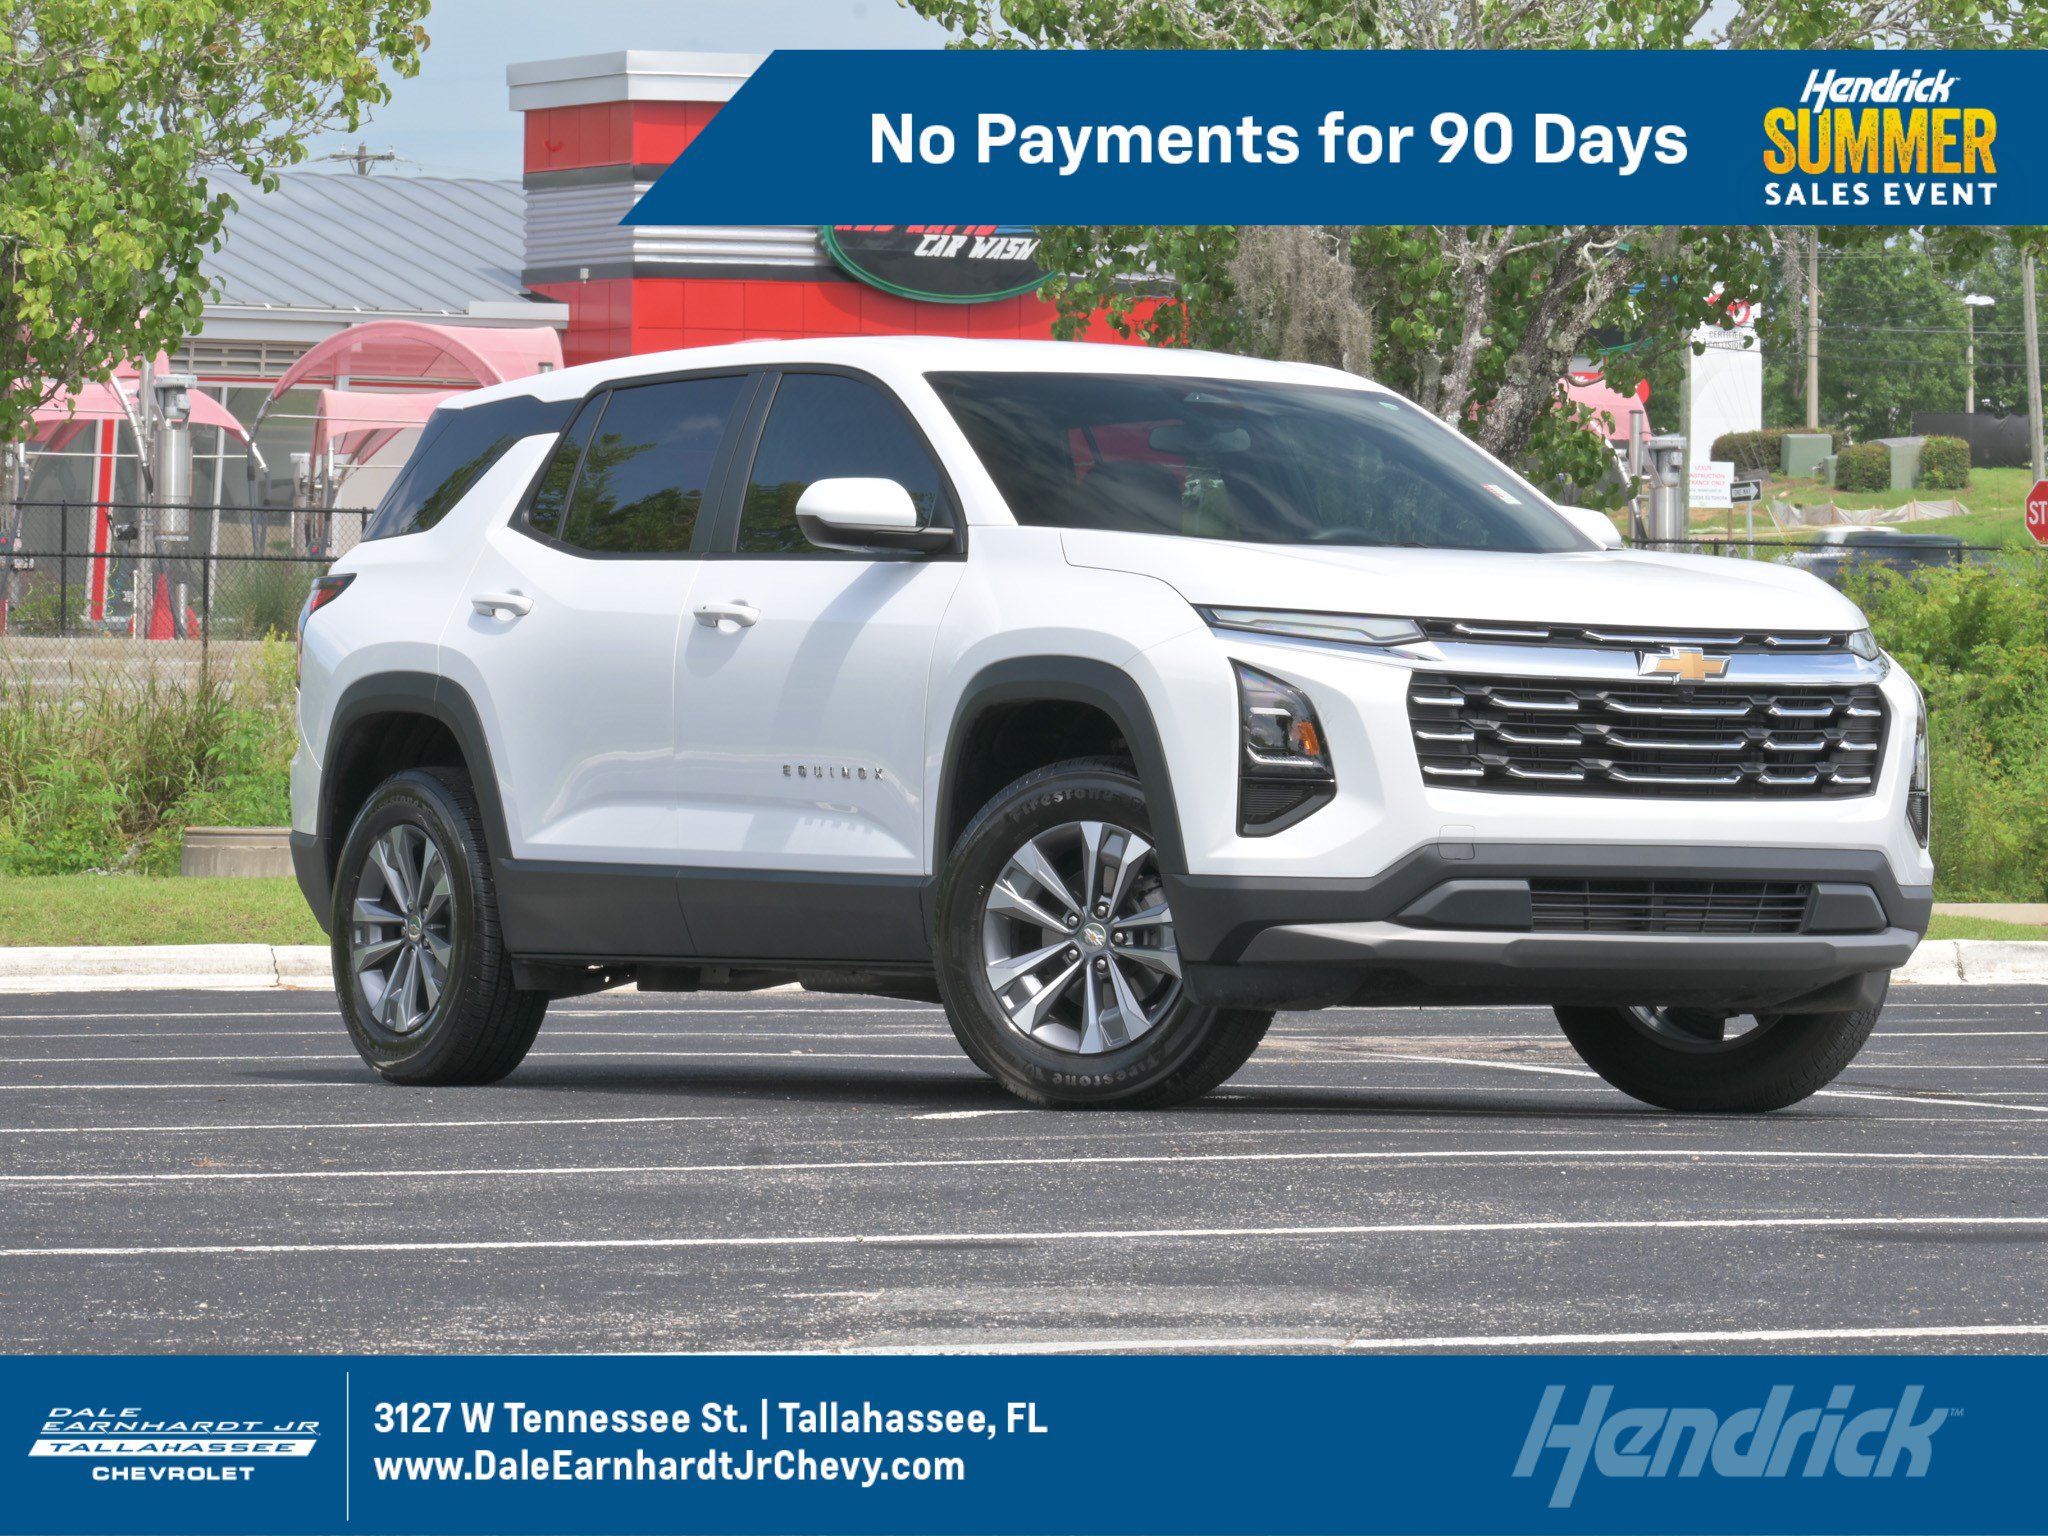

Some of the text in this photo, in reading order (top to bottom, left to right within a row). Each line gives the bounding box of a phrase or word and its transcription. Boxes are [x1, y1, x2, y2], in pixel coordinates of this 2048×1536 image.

[914, 233, 1041, 261] CAR WASH
[1709, 331, 1744, 339] CERTIFIED
[1708, 341, 1745, 350] COLLISION
[2028, 500, 2048, 525] ST
[783, 764, 883, 780] EQUINOX
